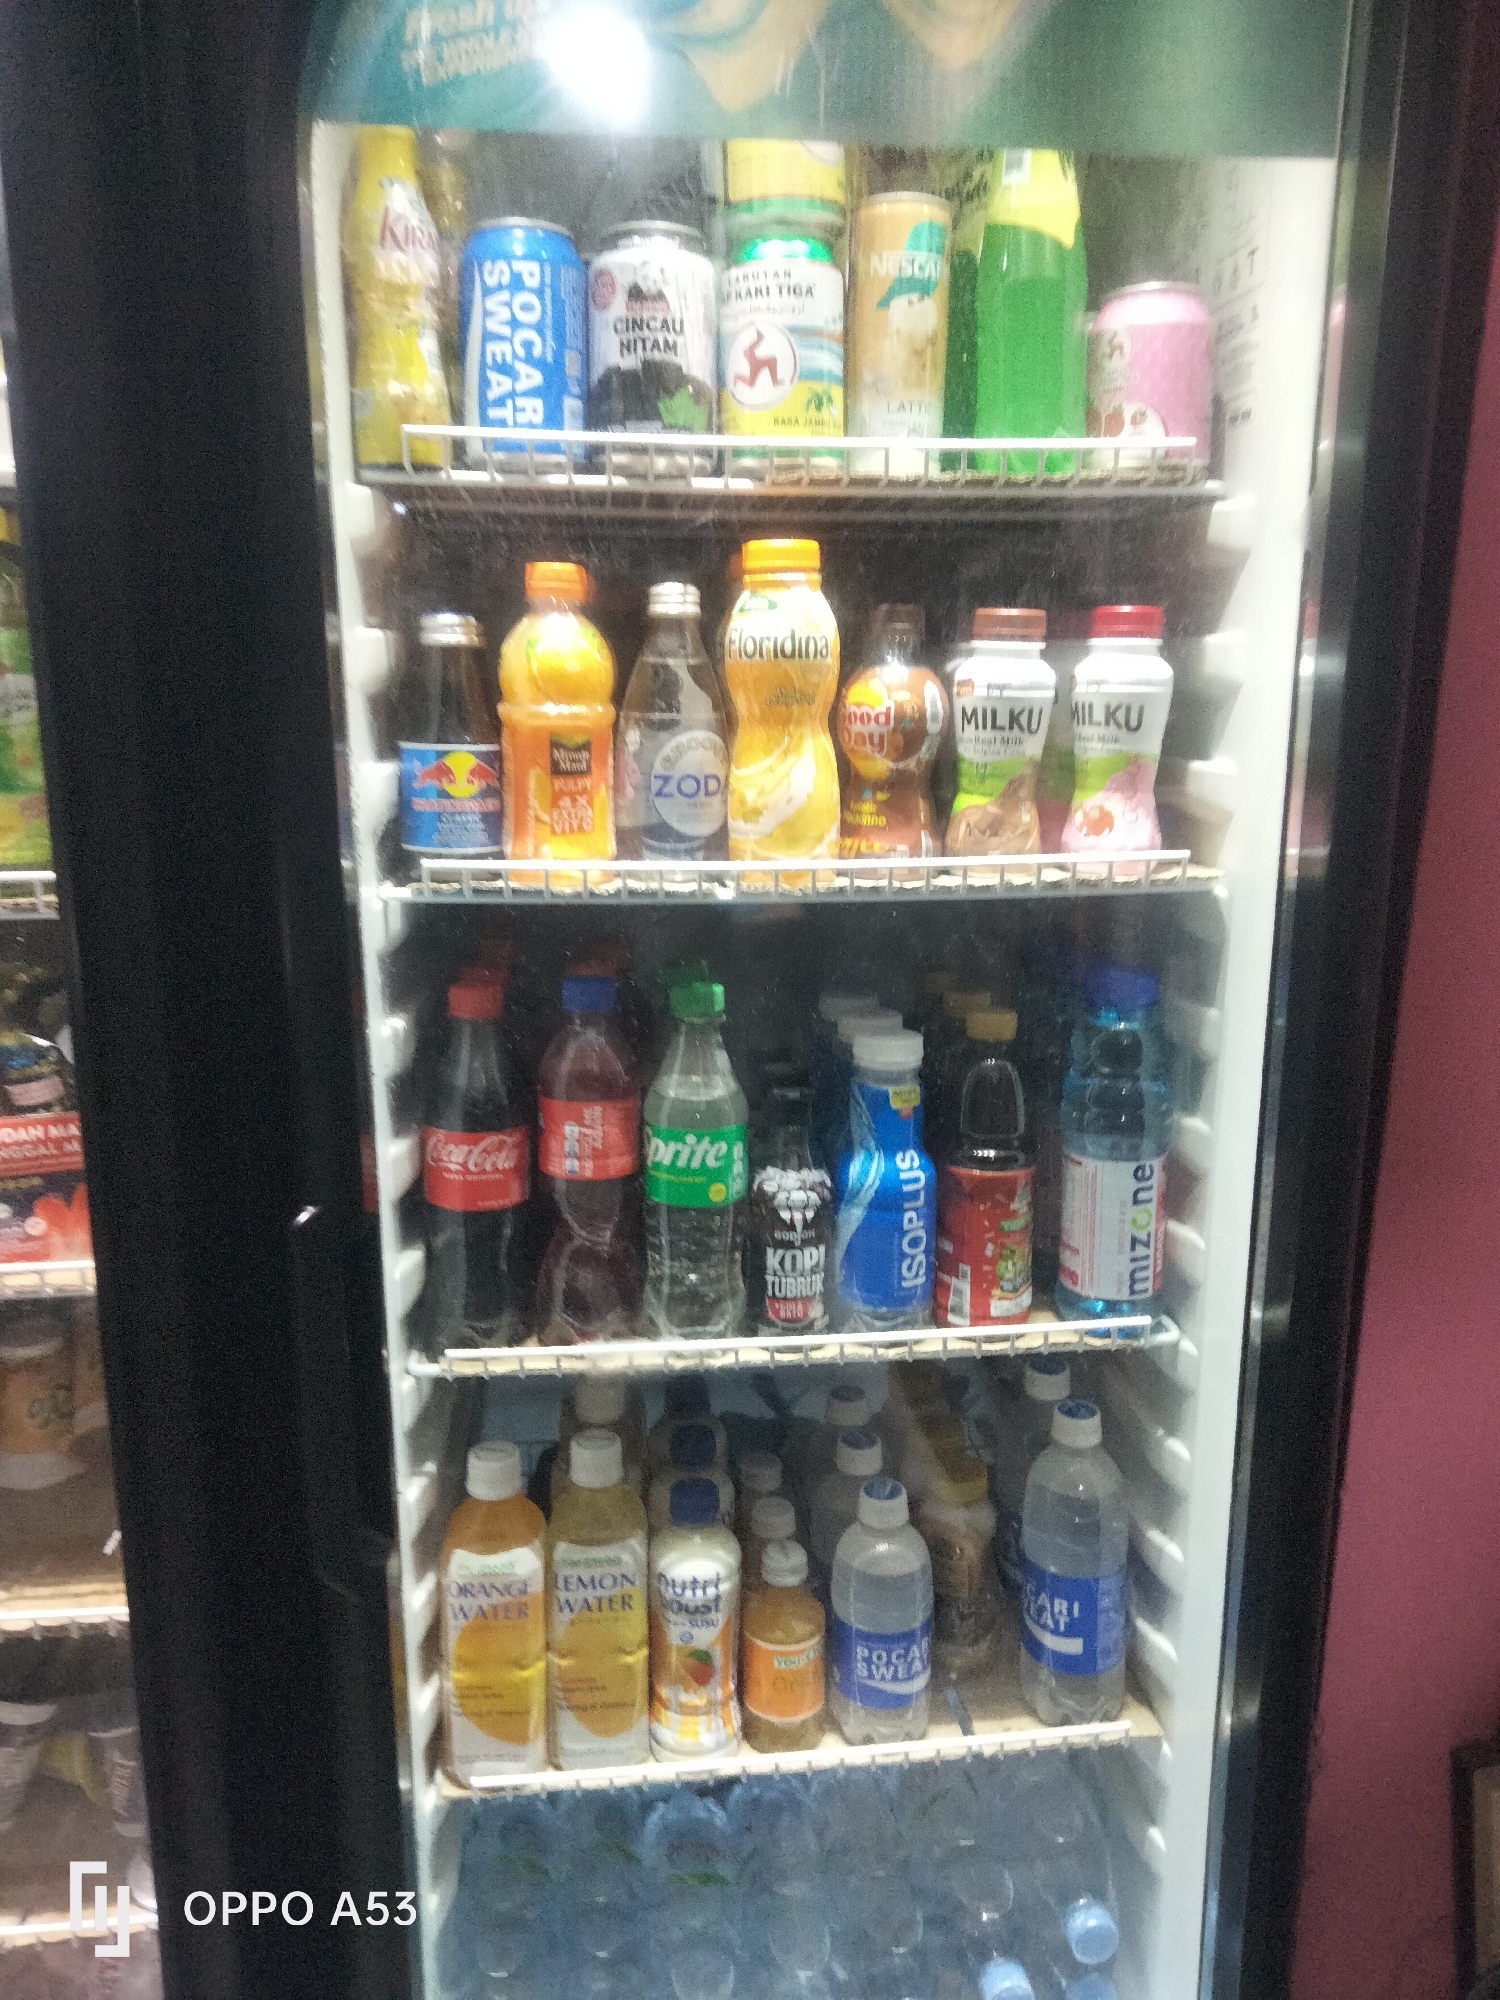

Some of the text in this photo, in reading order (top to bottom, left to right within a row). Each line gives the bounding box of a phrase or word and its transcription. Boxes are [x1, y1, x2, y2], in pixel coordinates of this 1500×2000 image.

[735, 284, 771, 302] KAKI
[776, 283, 815, 300] TIGA
[612, 315, 685, 337] CINCAU
[482, 259, 514, 428] SWEAT
[511, 259, 545, 426] POCAR
[619, 336, 678, 358] HITAM
[961, 704, 1043, 736] MILKU
[426, 1132, 521, 1172] Coca-Cola
[896, 1149, 926, 1288] ISOPLUS
[1128, 1162, 1155, 1297] mizone
[765, 1244, 826, 1277] KOPI
[764, 1271, 825, 1299] TUBRUK
[553, 1571, 637, 1594] LEMON
[451, 1601, 530, 1622] WATER
[556, 1593, 634, 1615] WATER
